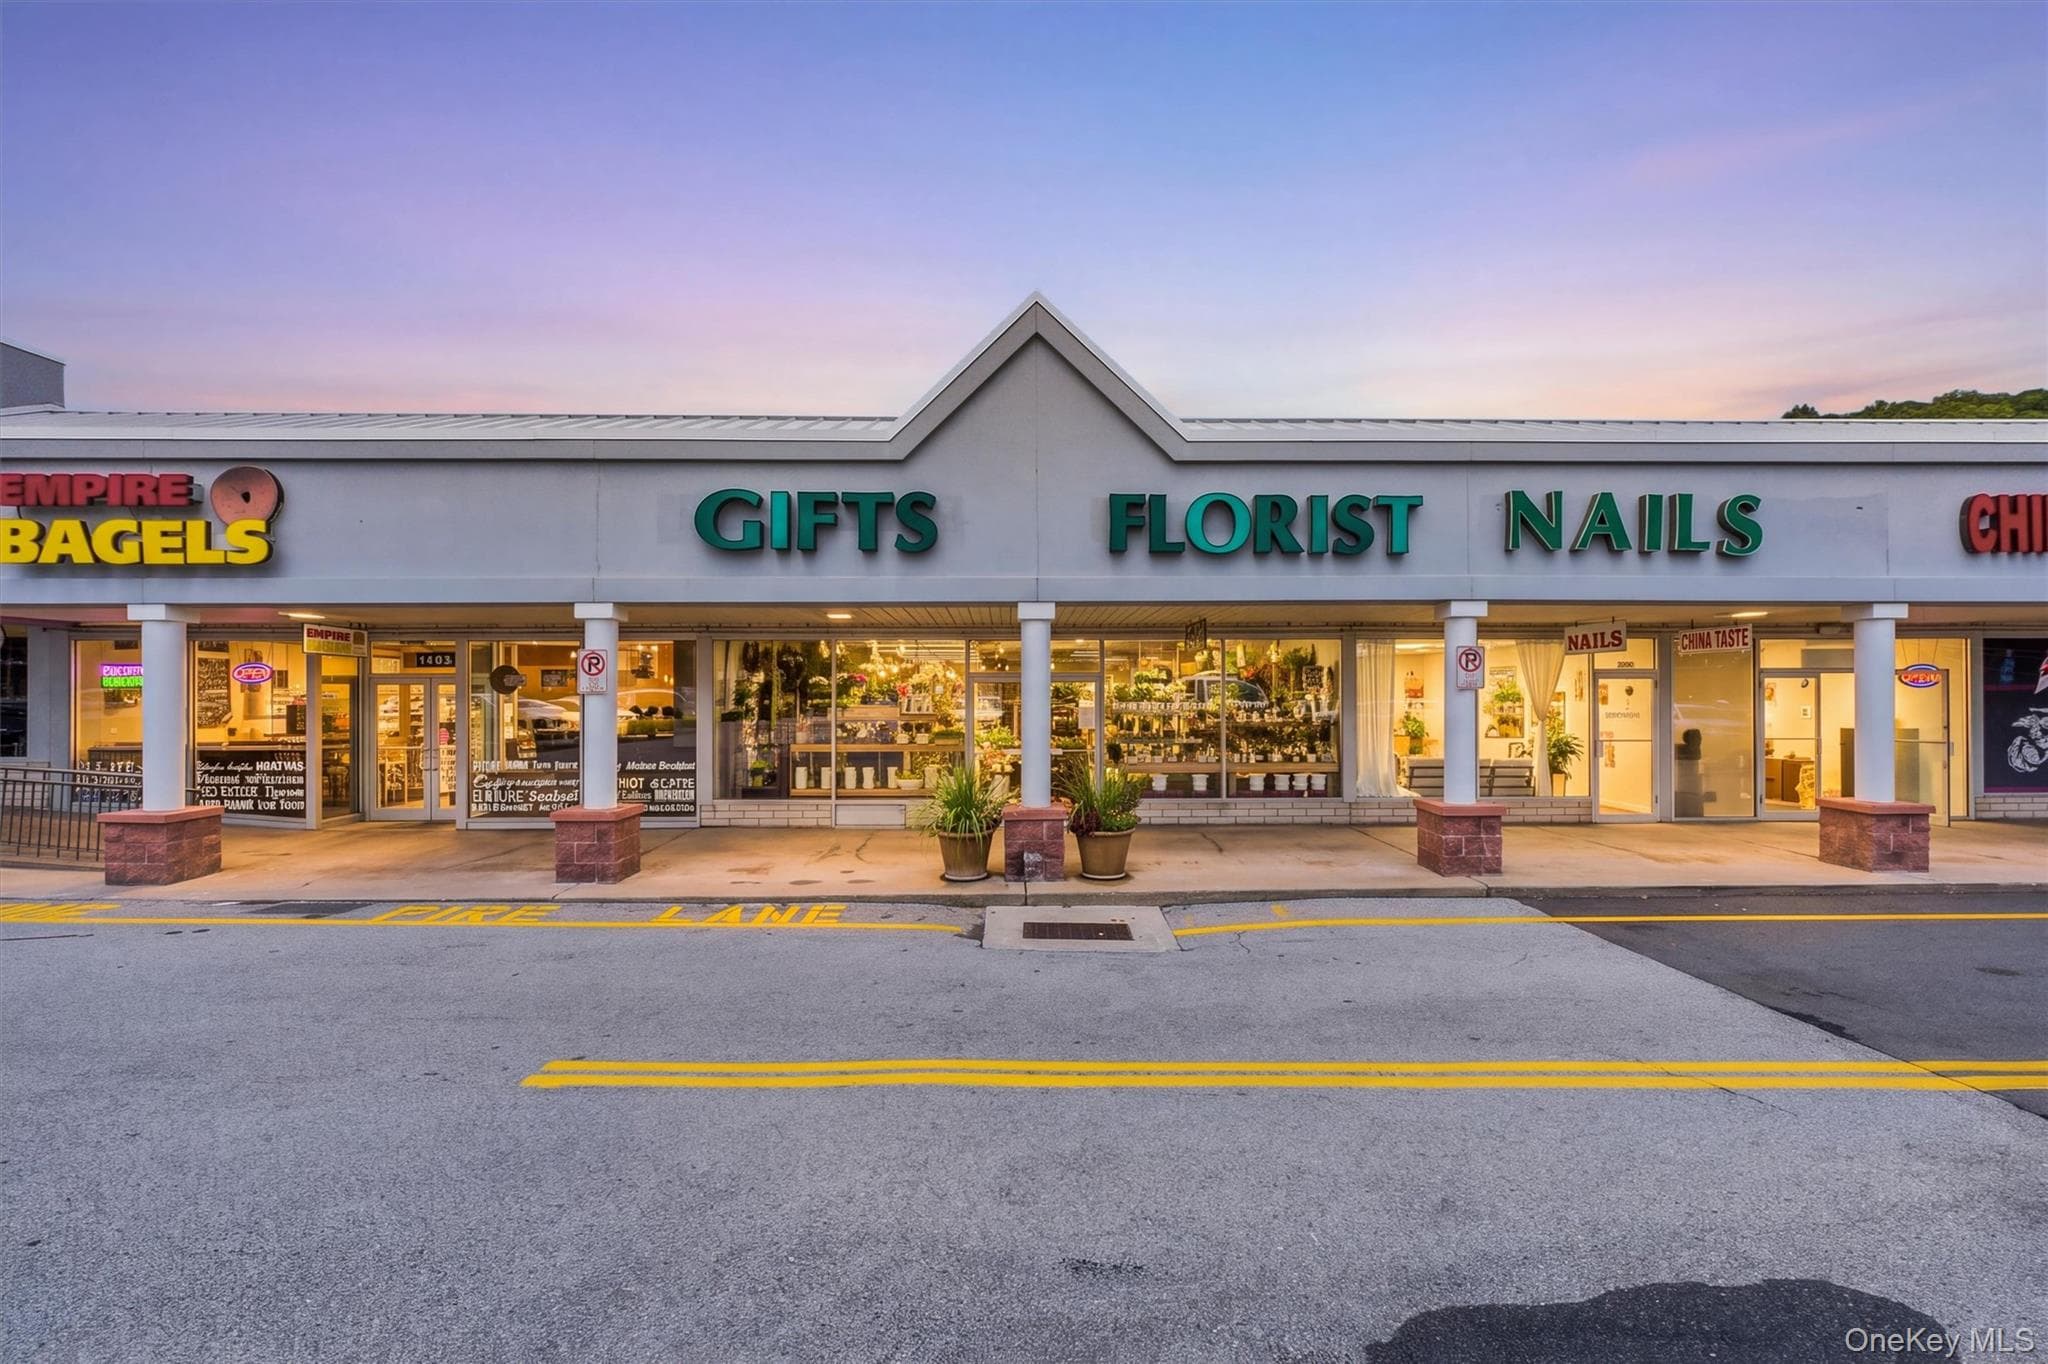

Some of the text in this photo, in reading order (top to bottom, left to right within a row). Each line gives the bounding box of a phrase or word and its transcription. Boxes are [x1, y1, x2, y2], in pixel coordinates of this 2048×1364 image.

[0, 473, 195, 507] EMPIRE
[0, 518, 271, 566] BAGELS
[694, 488, 939, 554] GIFTS
[1108, 492, 1424, 555] FLORIST
[1504, 490, 1764, 557] NAILS
[1959, 493, 2048, 554] CHI
[306, 628, 351, 642] EMPIRE
[1567, 630, 1624, 650] NAILS
[1681, 628, 1749, 650] CHINA TASTE
